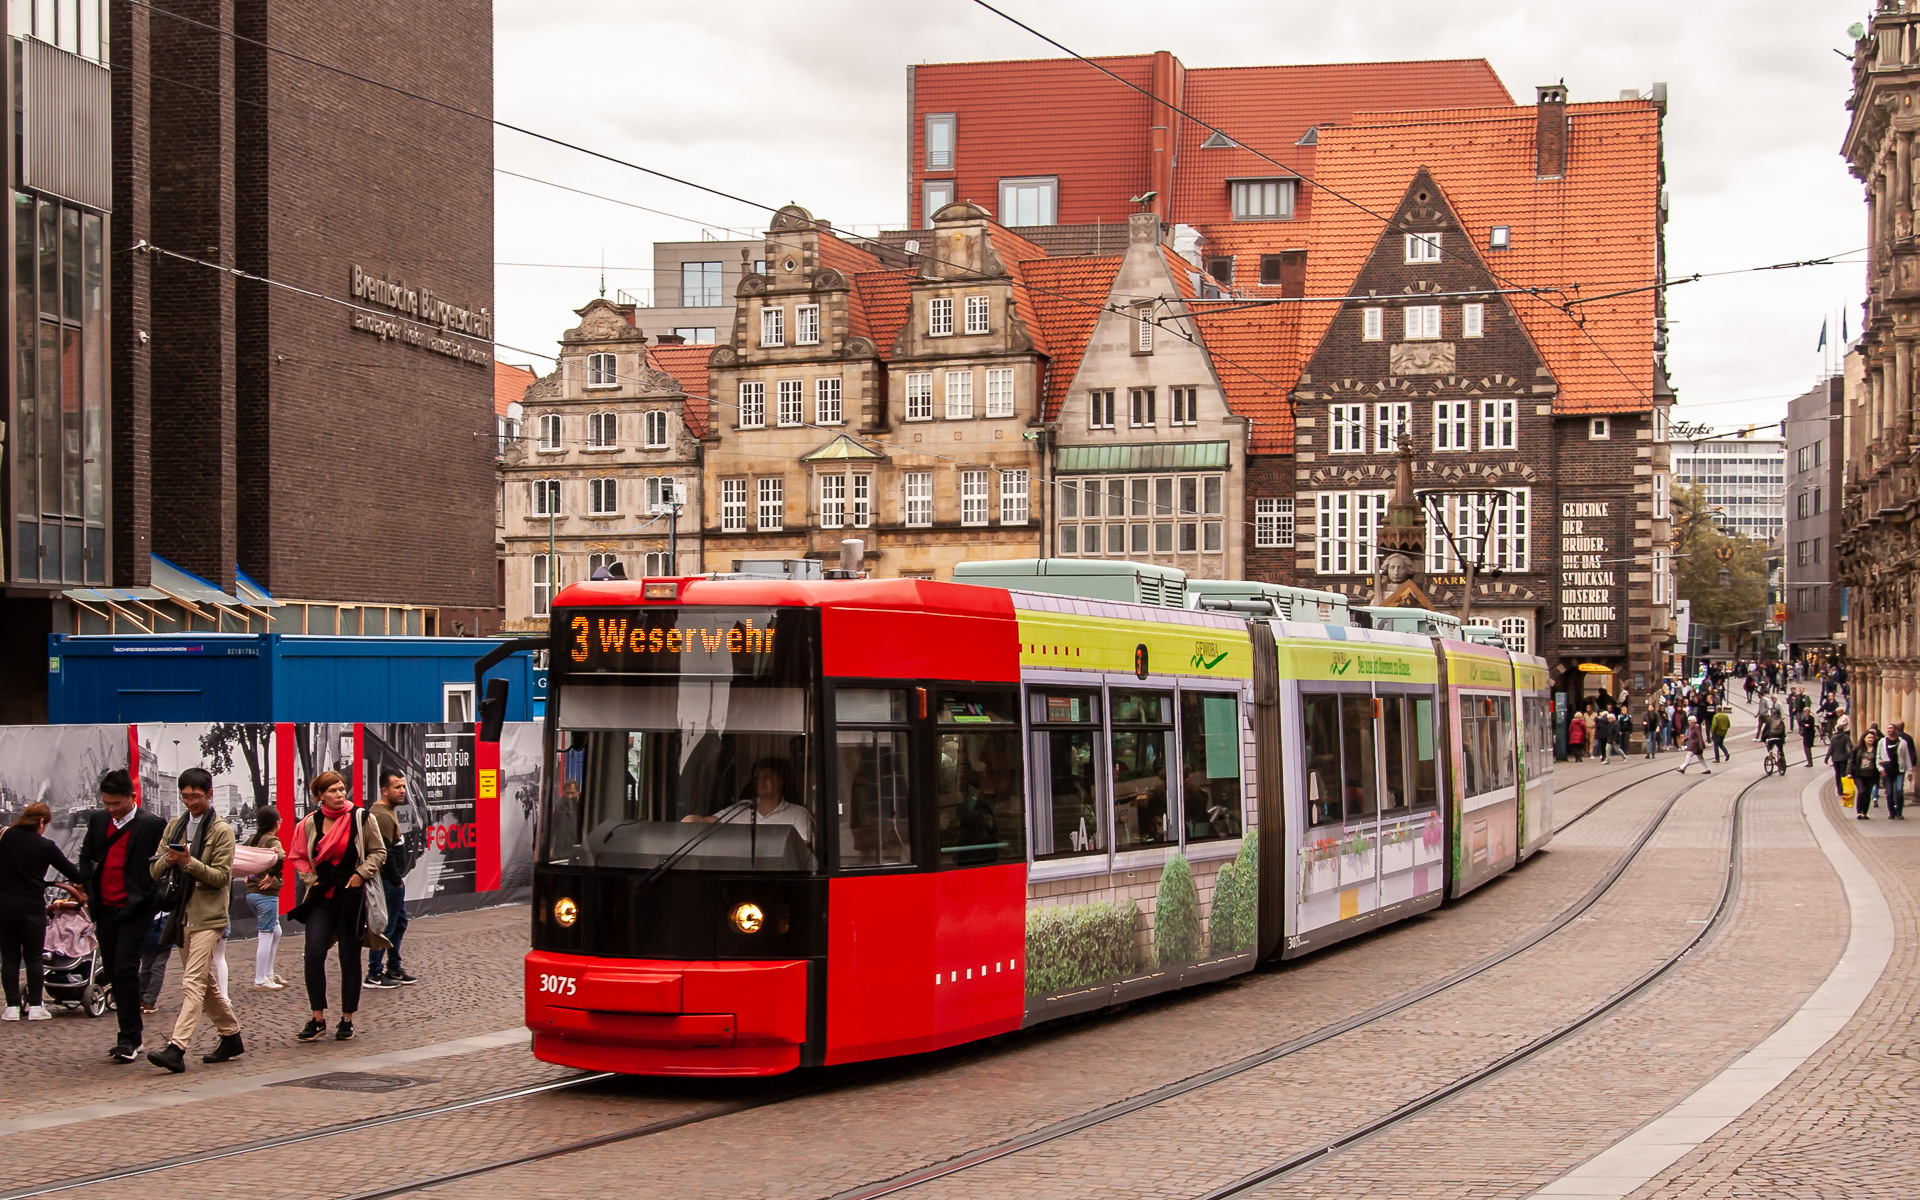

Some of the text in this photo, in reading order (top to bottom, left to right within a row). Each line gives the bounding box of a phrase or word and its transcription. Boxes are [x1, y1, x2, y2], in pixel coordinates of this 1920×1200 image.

[351, 263, 493, 340] Bremische Bürgerschaft
[1562, 502, 1608, 517] GEDENKE
[1562, 520, 1583, 535] DER
[1562, 535, 1609, 552] BRÜDER,
[1562, 555, 1601, 569] DIE DAS
[1562, 572, 1615, 586] SCHICKSAL
[1562, 589, 1608, 604] UNSERER
[1562, 606, 1616, 621] TRENNUNG
[571, 616, 776, 662] 3 Weserwehr
[1195, 641, 1218, 657] GEWOBA
[425, 749, 469, 768] BILDER FÜR
[426, 771, 457, 787] BREMEN
[426, 823, 476, 851] FOCKE
[539, 974, 576, 996] 3075
